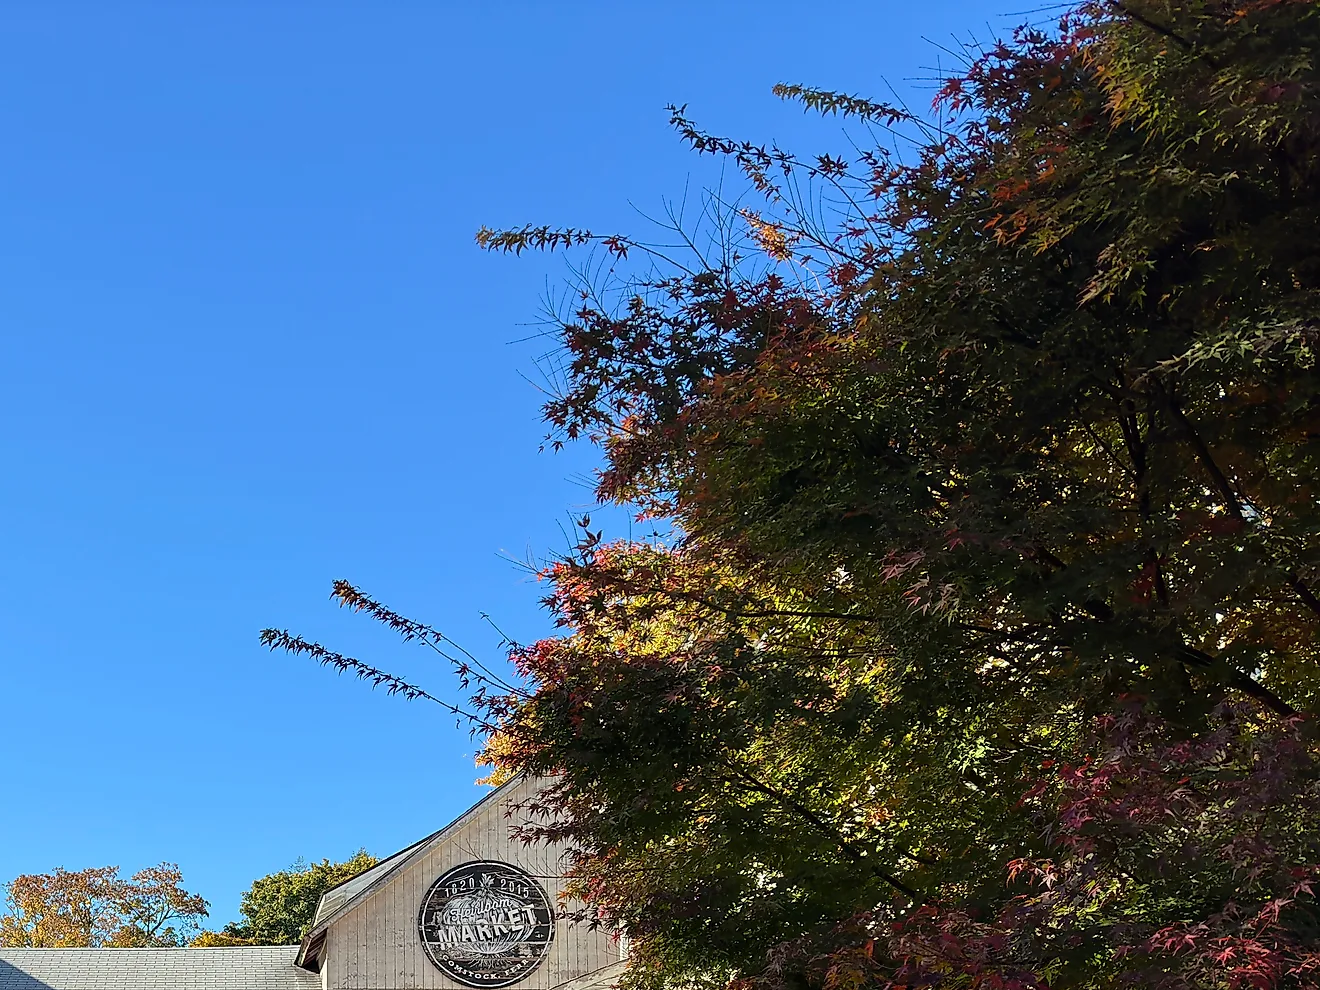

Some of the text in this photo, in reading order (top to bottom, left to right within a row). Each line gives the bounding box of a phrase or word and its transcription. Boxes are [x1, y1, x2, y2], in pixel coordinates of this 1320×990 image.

[445, 877, 529, 899] 1820 2015
[450, 898, 513, 921] Heirloom
[438, 903, 537, 951] MARKET
